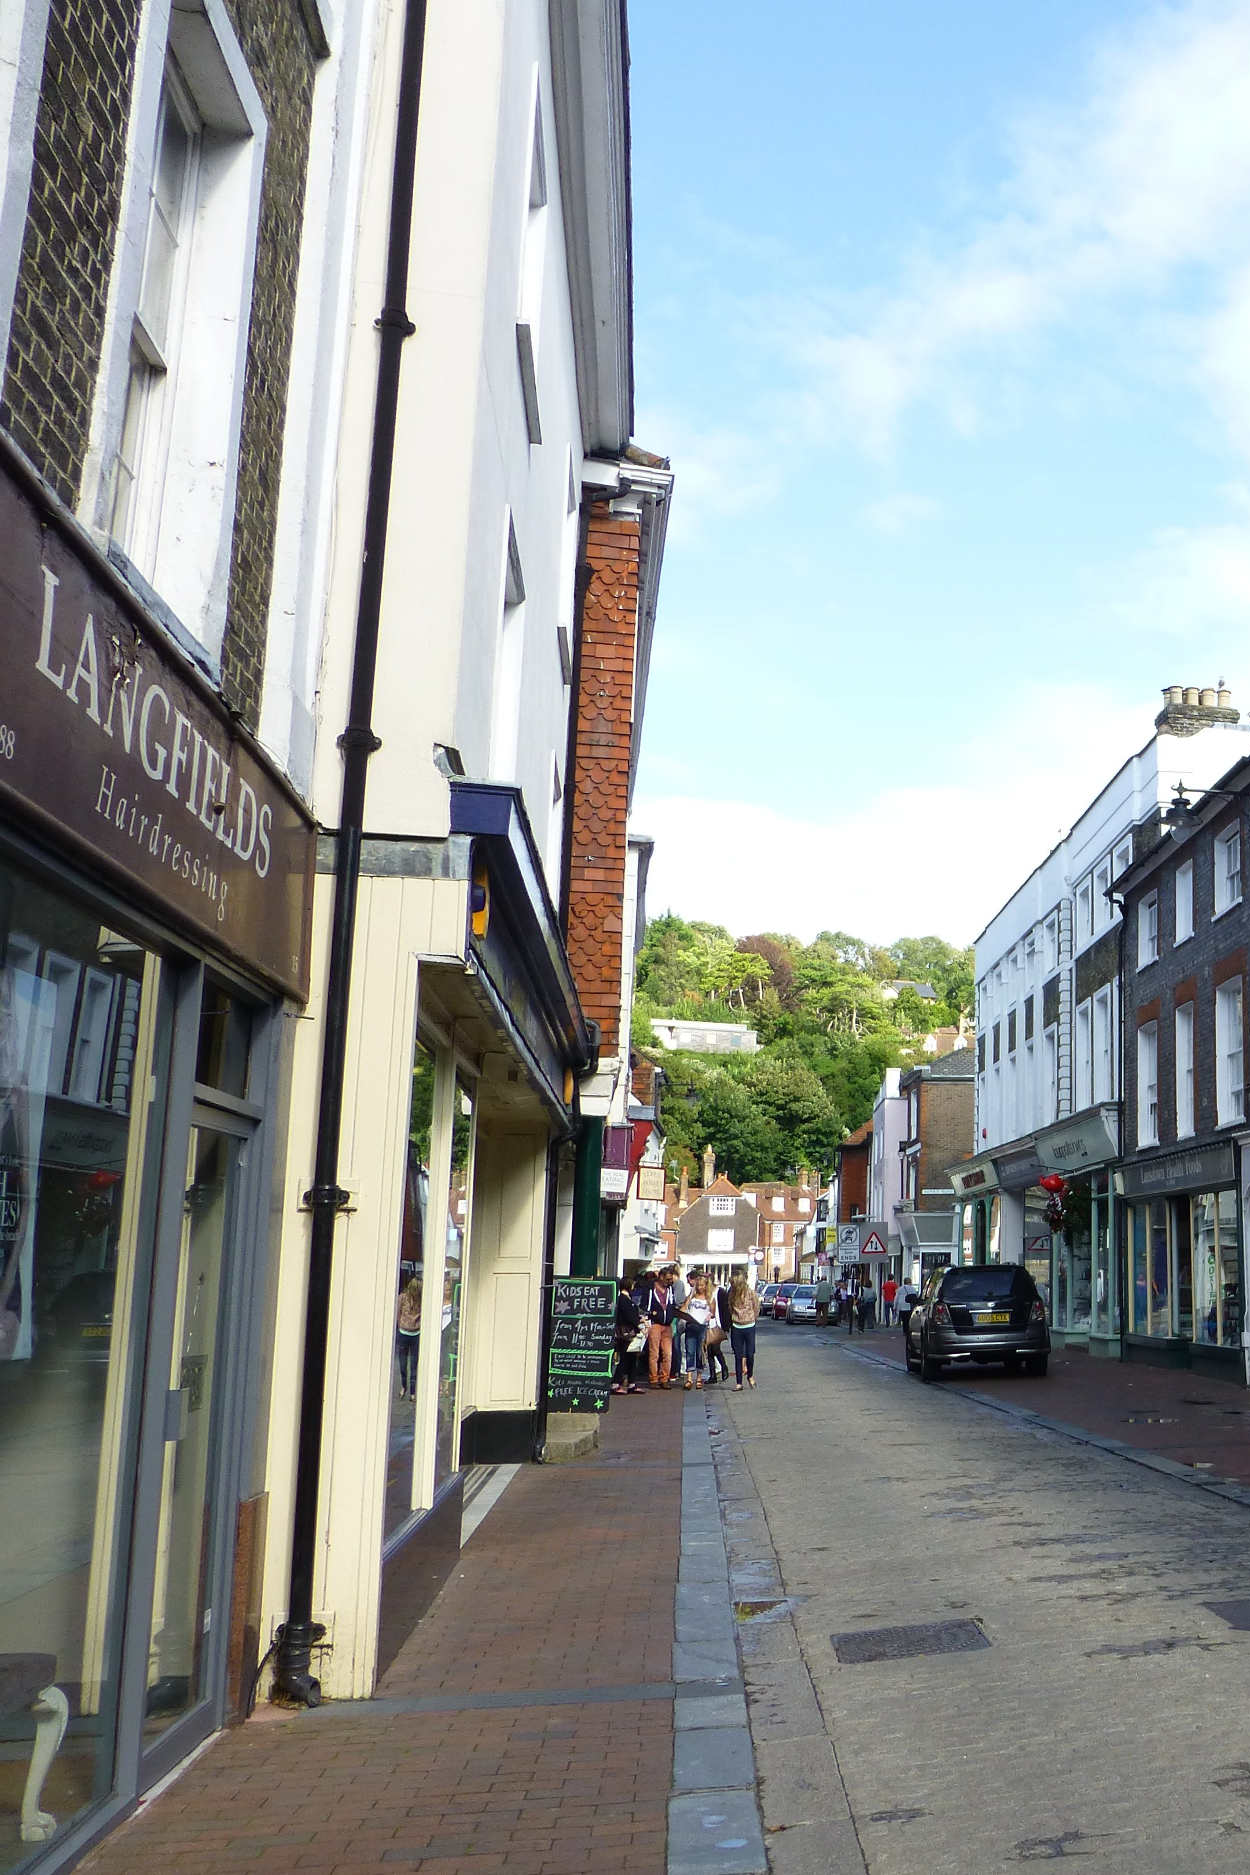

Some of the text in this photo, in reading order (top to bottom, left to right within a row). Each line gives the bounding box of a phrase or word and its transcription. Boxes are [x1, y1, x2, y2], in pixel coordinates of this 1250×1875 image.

[36, 565, 273, 879] LANGFIELDS
[95, 765, 229, 921] Hairdressing
[557, 1284, 601, 1298] KIDS EAT
[574, 1298, 606, 1312] FREE
